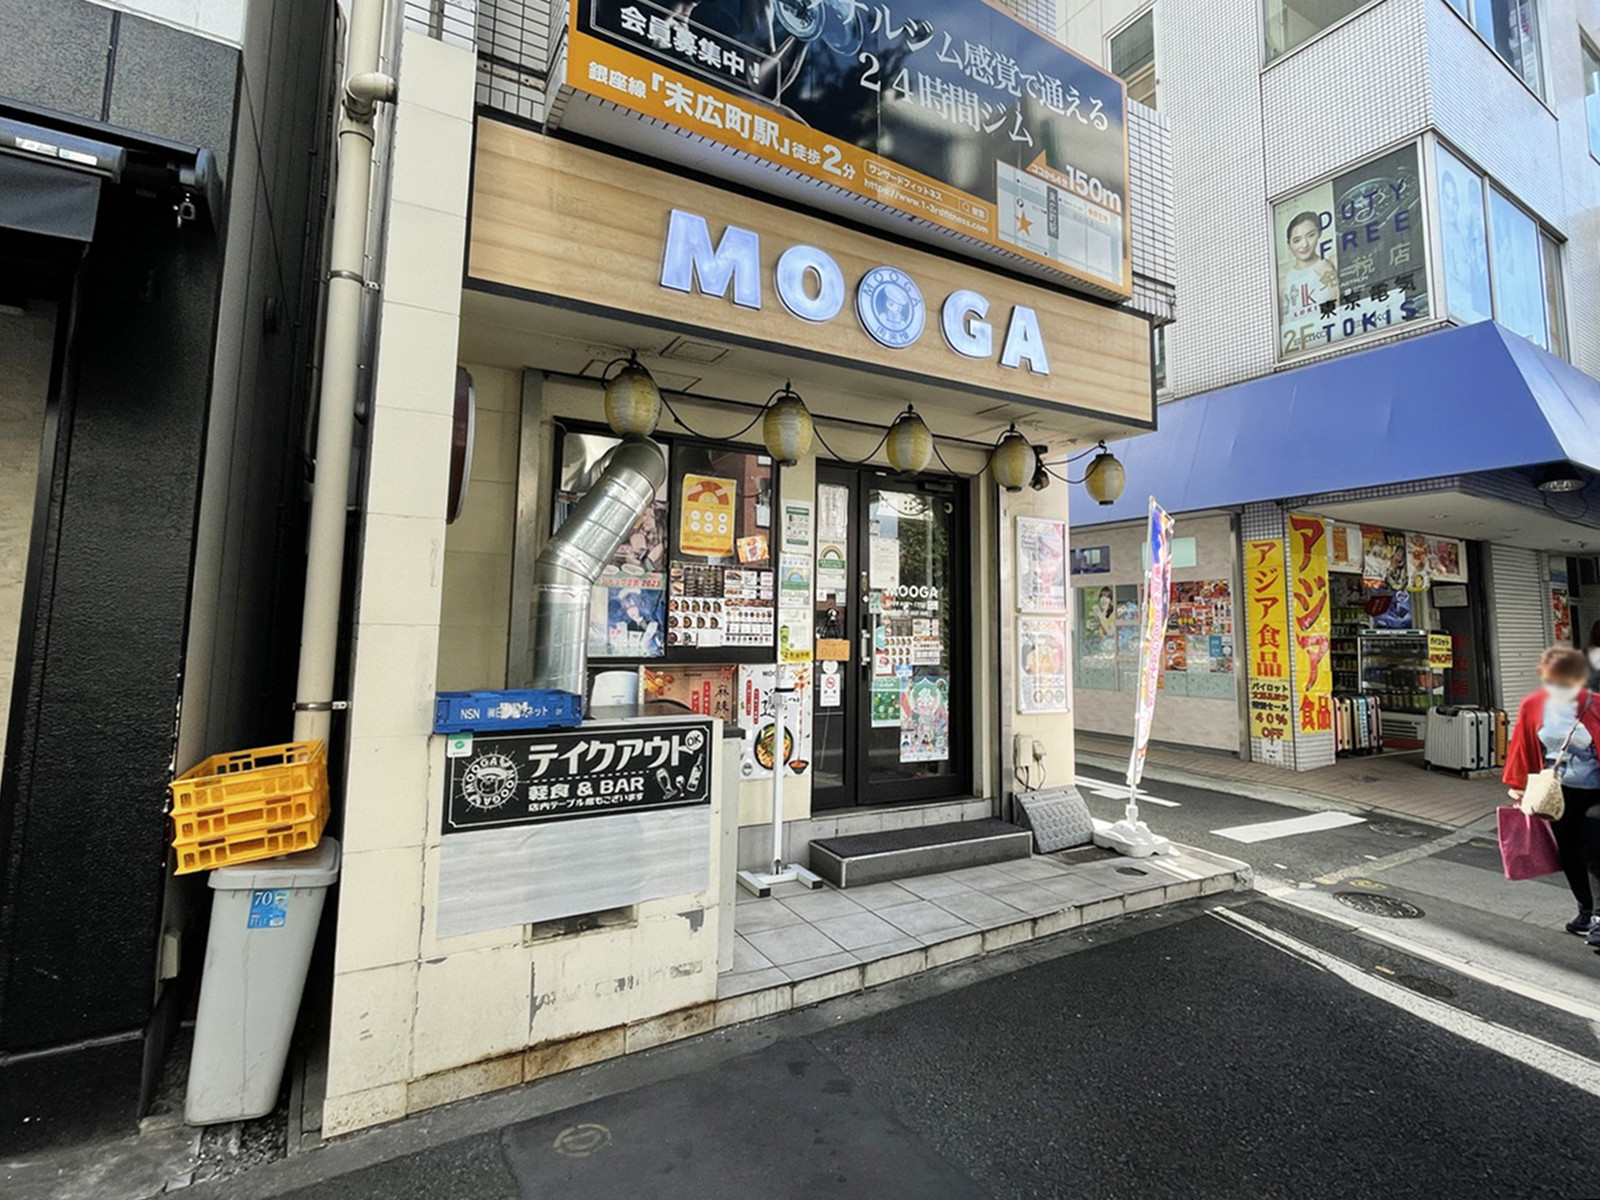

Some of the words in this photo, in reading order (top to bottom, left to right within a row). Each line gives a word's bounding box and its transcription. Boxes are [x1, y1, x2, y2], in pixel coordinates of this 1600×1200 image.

[1066, 164, 1122, 213] 150m
[1318, 178, 1406, 232] DUTY
[1319, 209, 1412, 261] FREE
[1251, 540, 1283, 678] アジア食品
[1289, 514, 1331, 692] アジア
[460, 708, 481, 720] NSN
[1300, 694, 1332, 732] 食品
[528, 734, 694, 778] テイクアウト
[686, 735, 702, 747] OK
[528, 783, 571, 801] 軽食
[599, 776, 646, 795] BAR
[255, 891, 273, 906] 70
